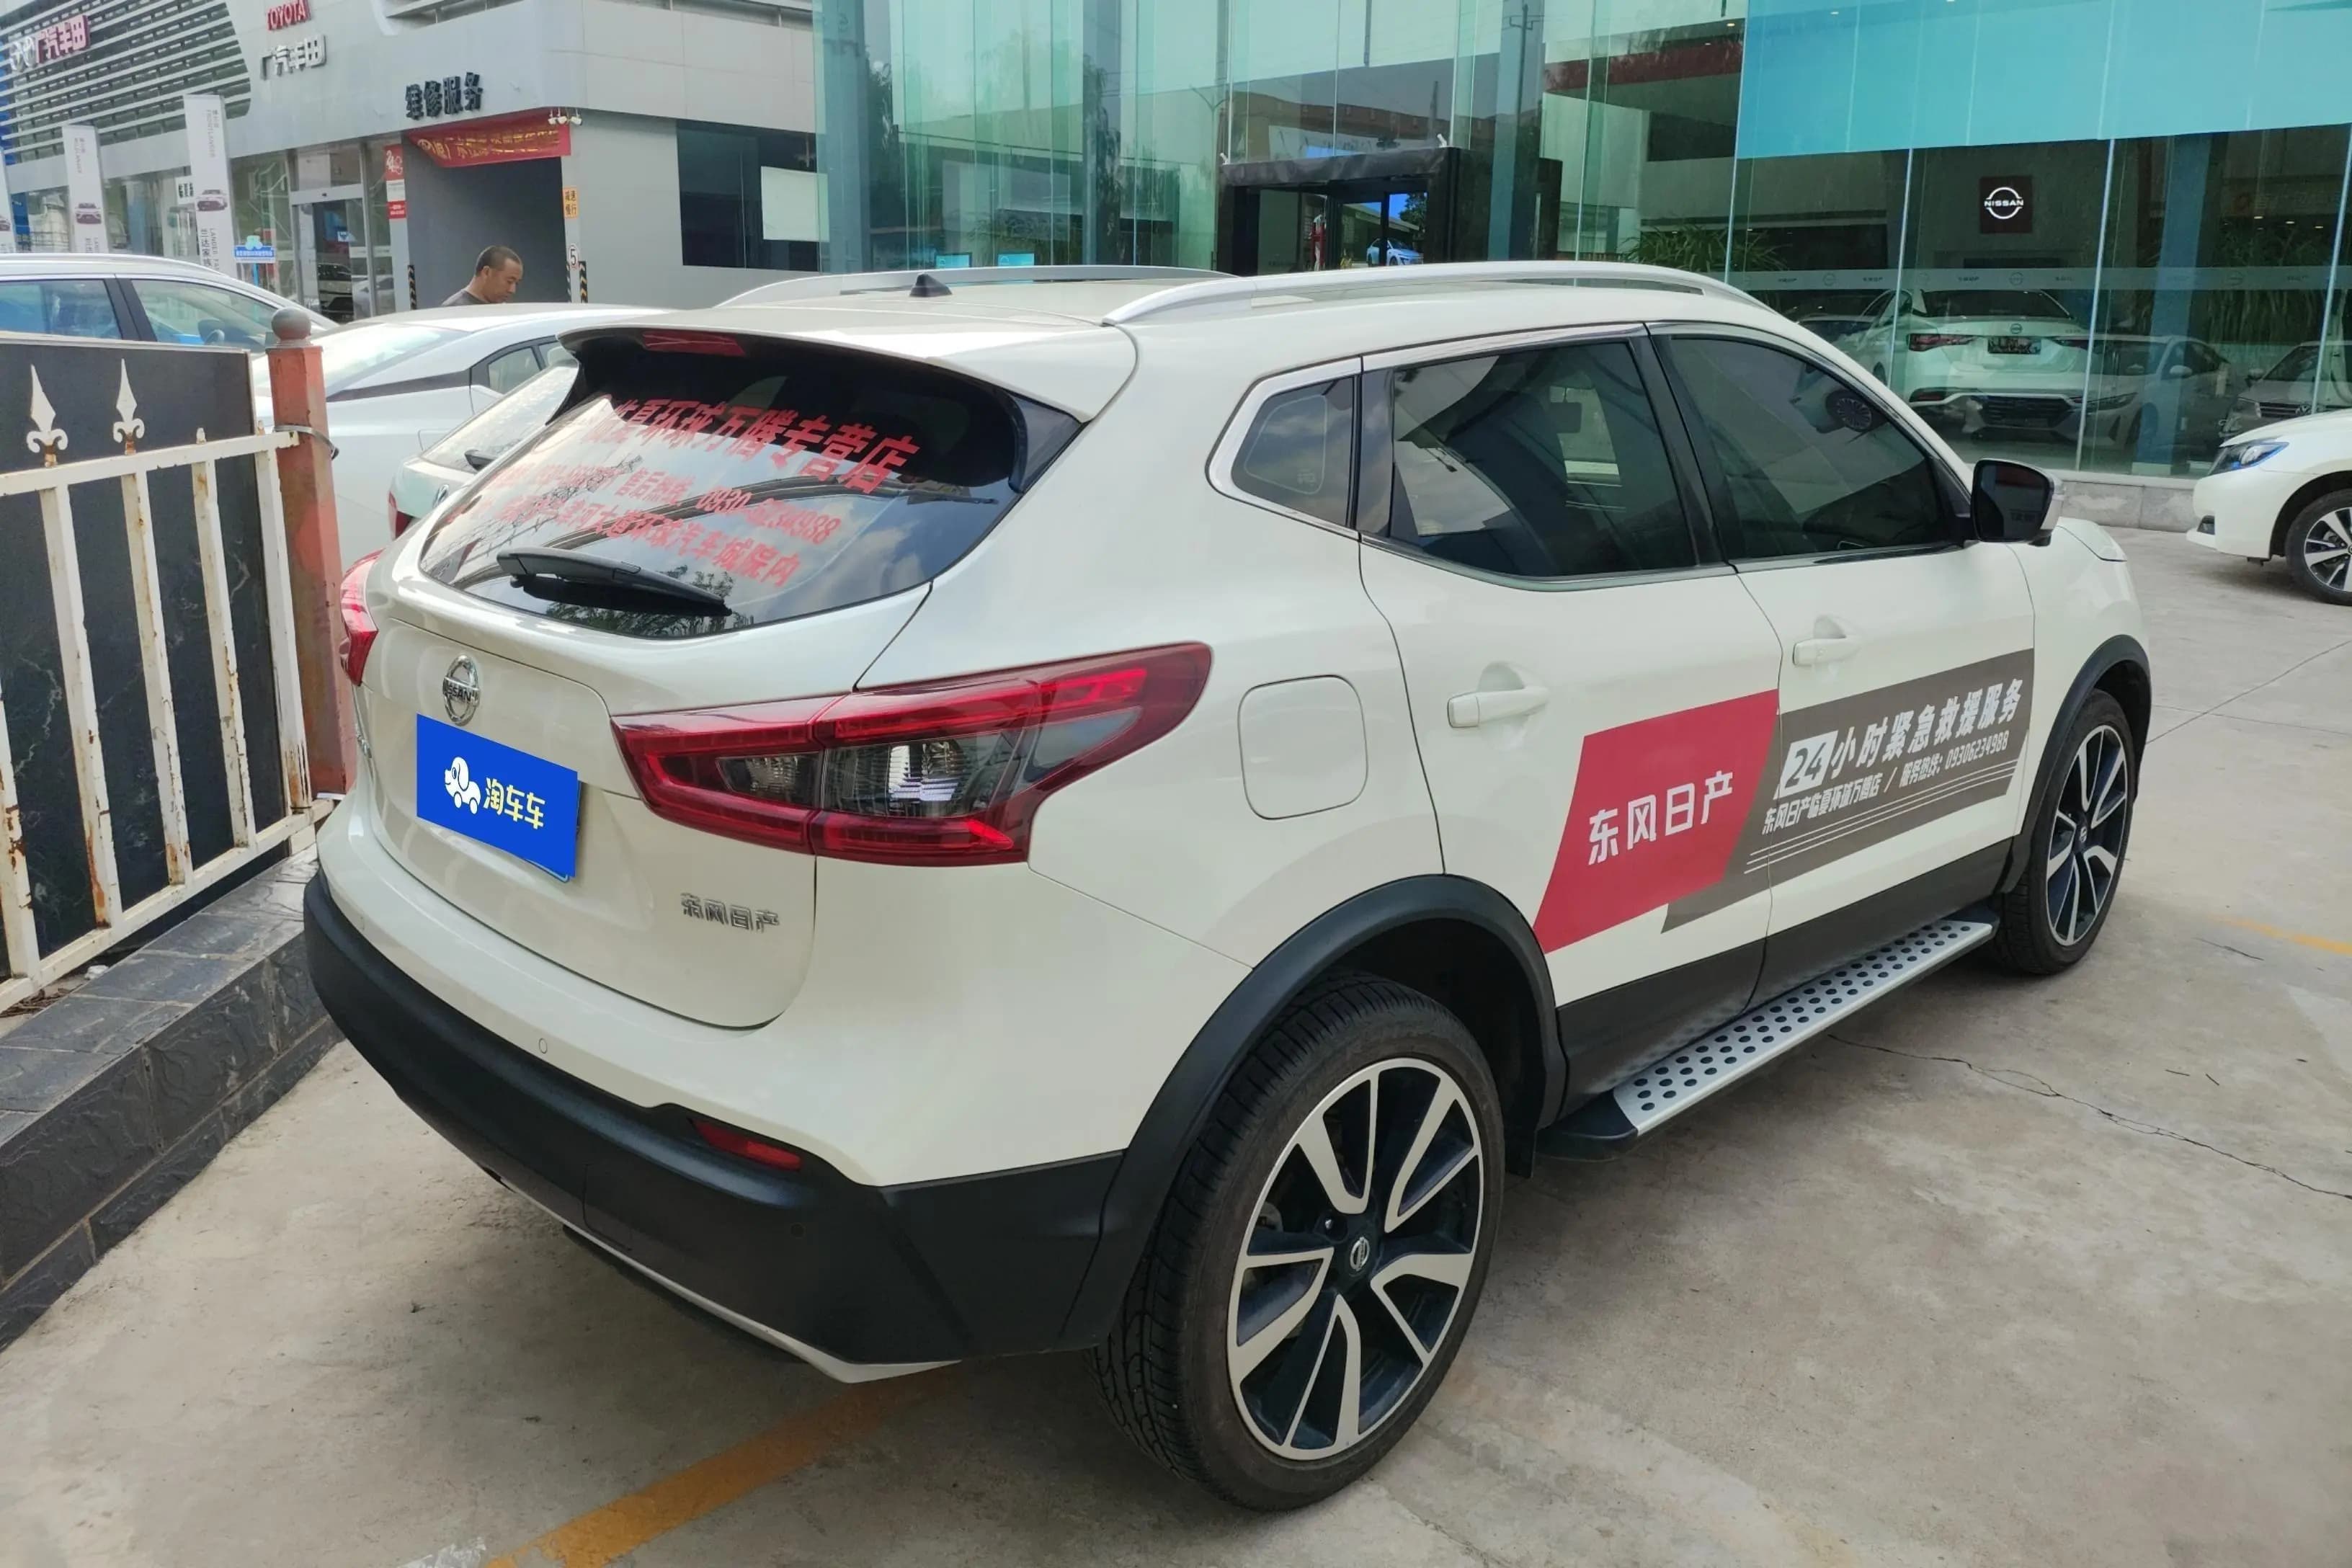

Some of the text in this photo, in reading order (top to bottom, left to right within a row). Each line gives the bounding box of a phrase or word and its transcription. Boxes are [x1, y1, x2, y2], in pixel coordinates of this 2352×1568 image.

[267, 0, 311, 30] TOYOTA
[37, 14, 90, 64] 广汽丰田
[260, 35, 326, 81] 广汽丰田
[570, 249, 576, 266] 5
[1588, 770, 1733, 865] 东风日产
[681, 892, 780, 933] 东风日产
